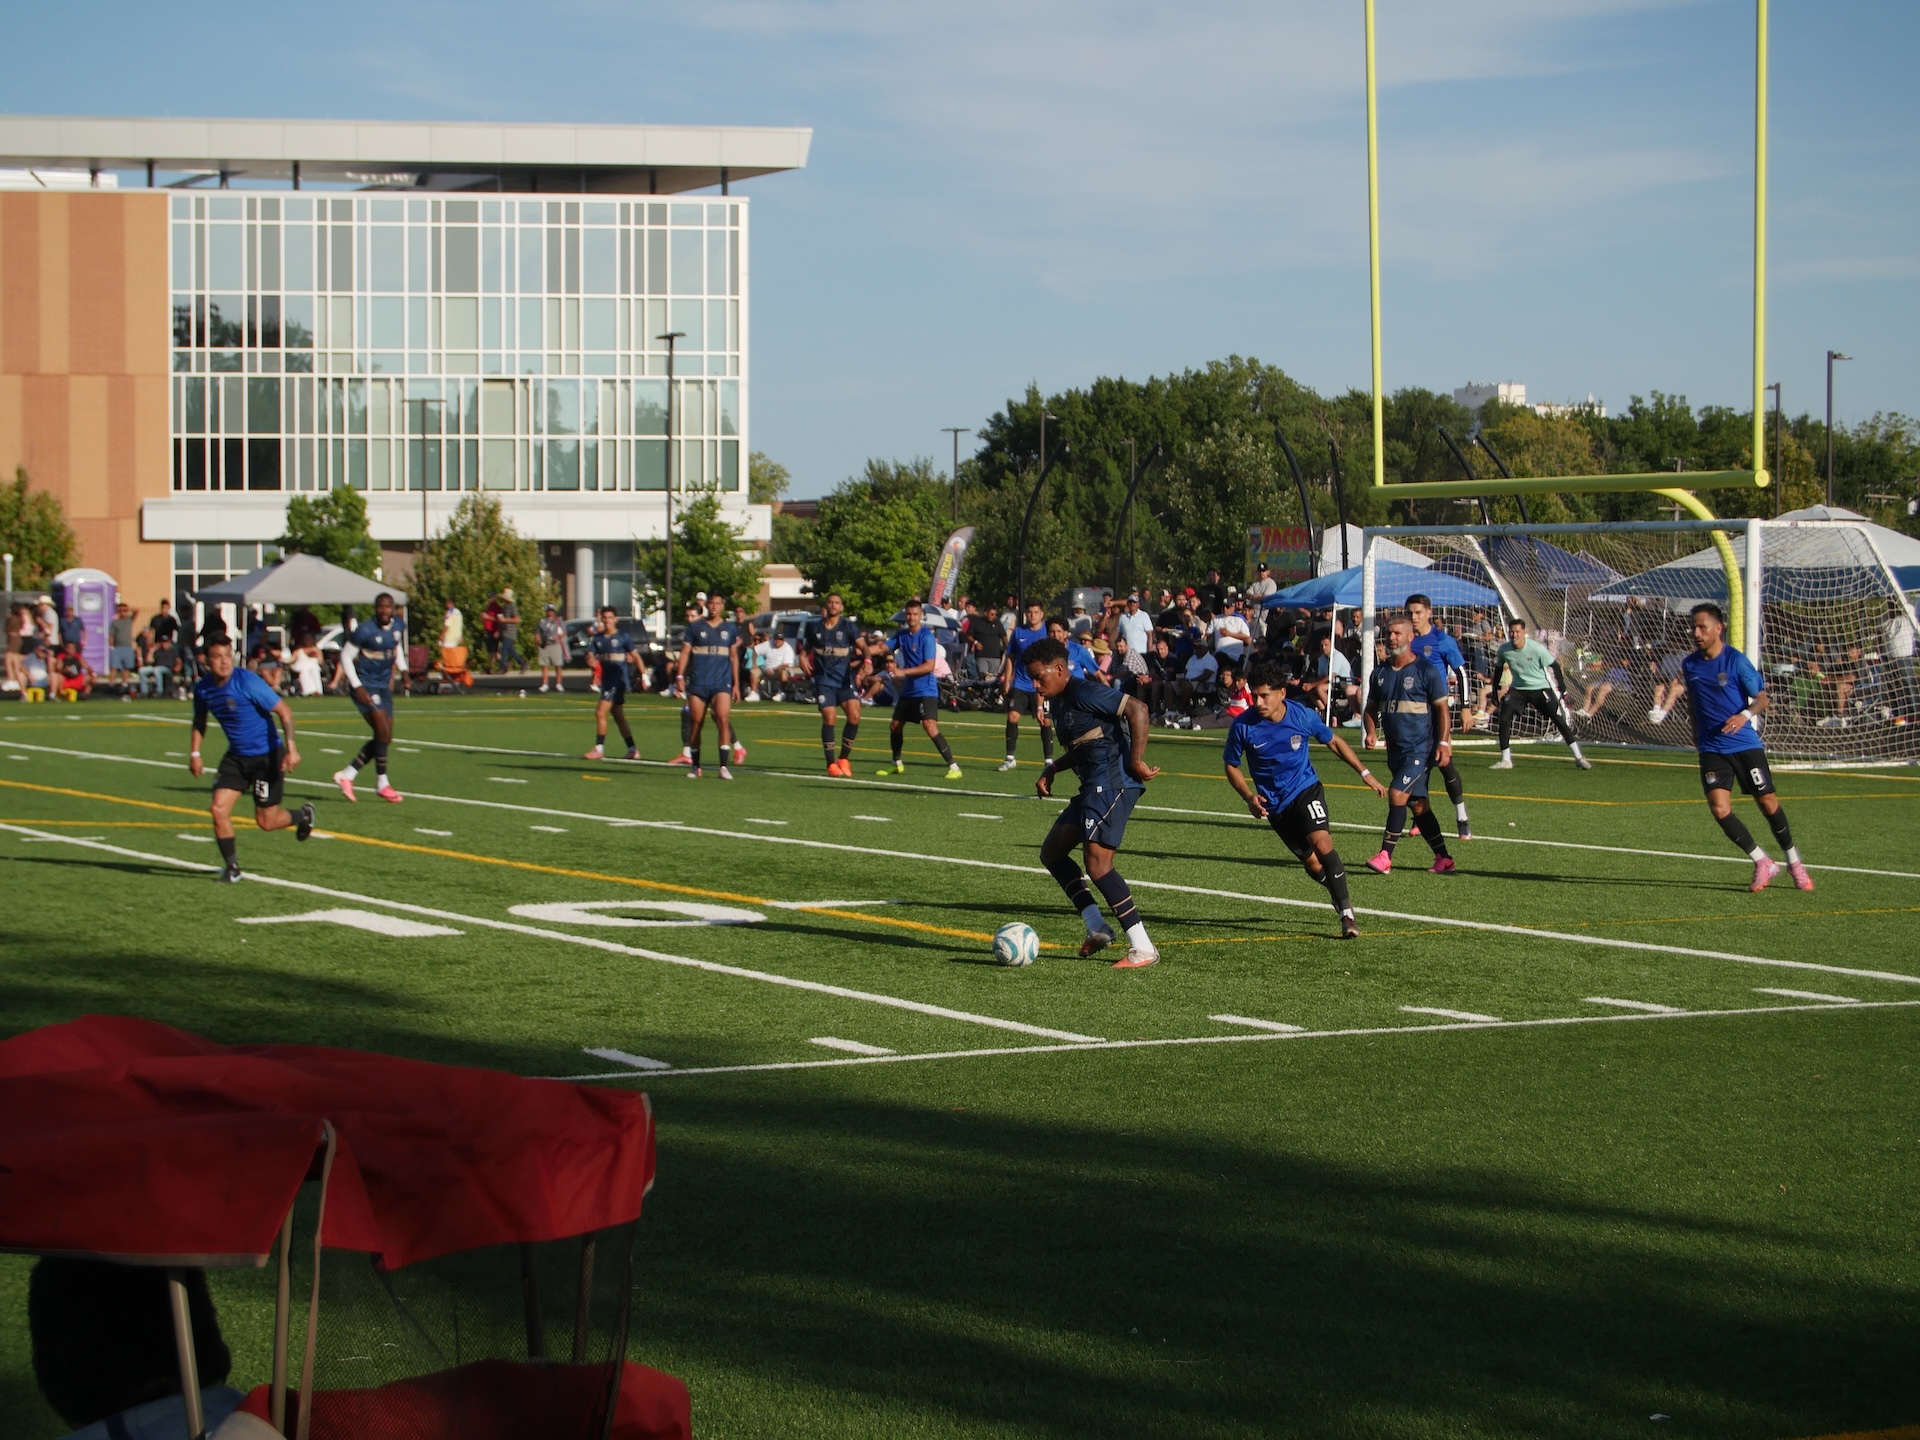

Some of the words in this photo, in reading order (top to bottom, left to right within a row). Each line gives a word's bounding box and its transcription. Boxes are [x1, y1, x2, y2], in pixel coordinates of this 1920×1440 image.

[940, 553, 953, 578] STEM
[1387, 700, 1396, 713] 15
[1750, 767, 1763, 785] 8
[1307, 800, 1326, 819] 16
